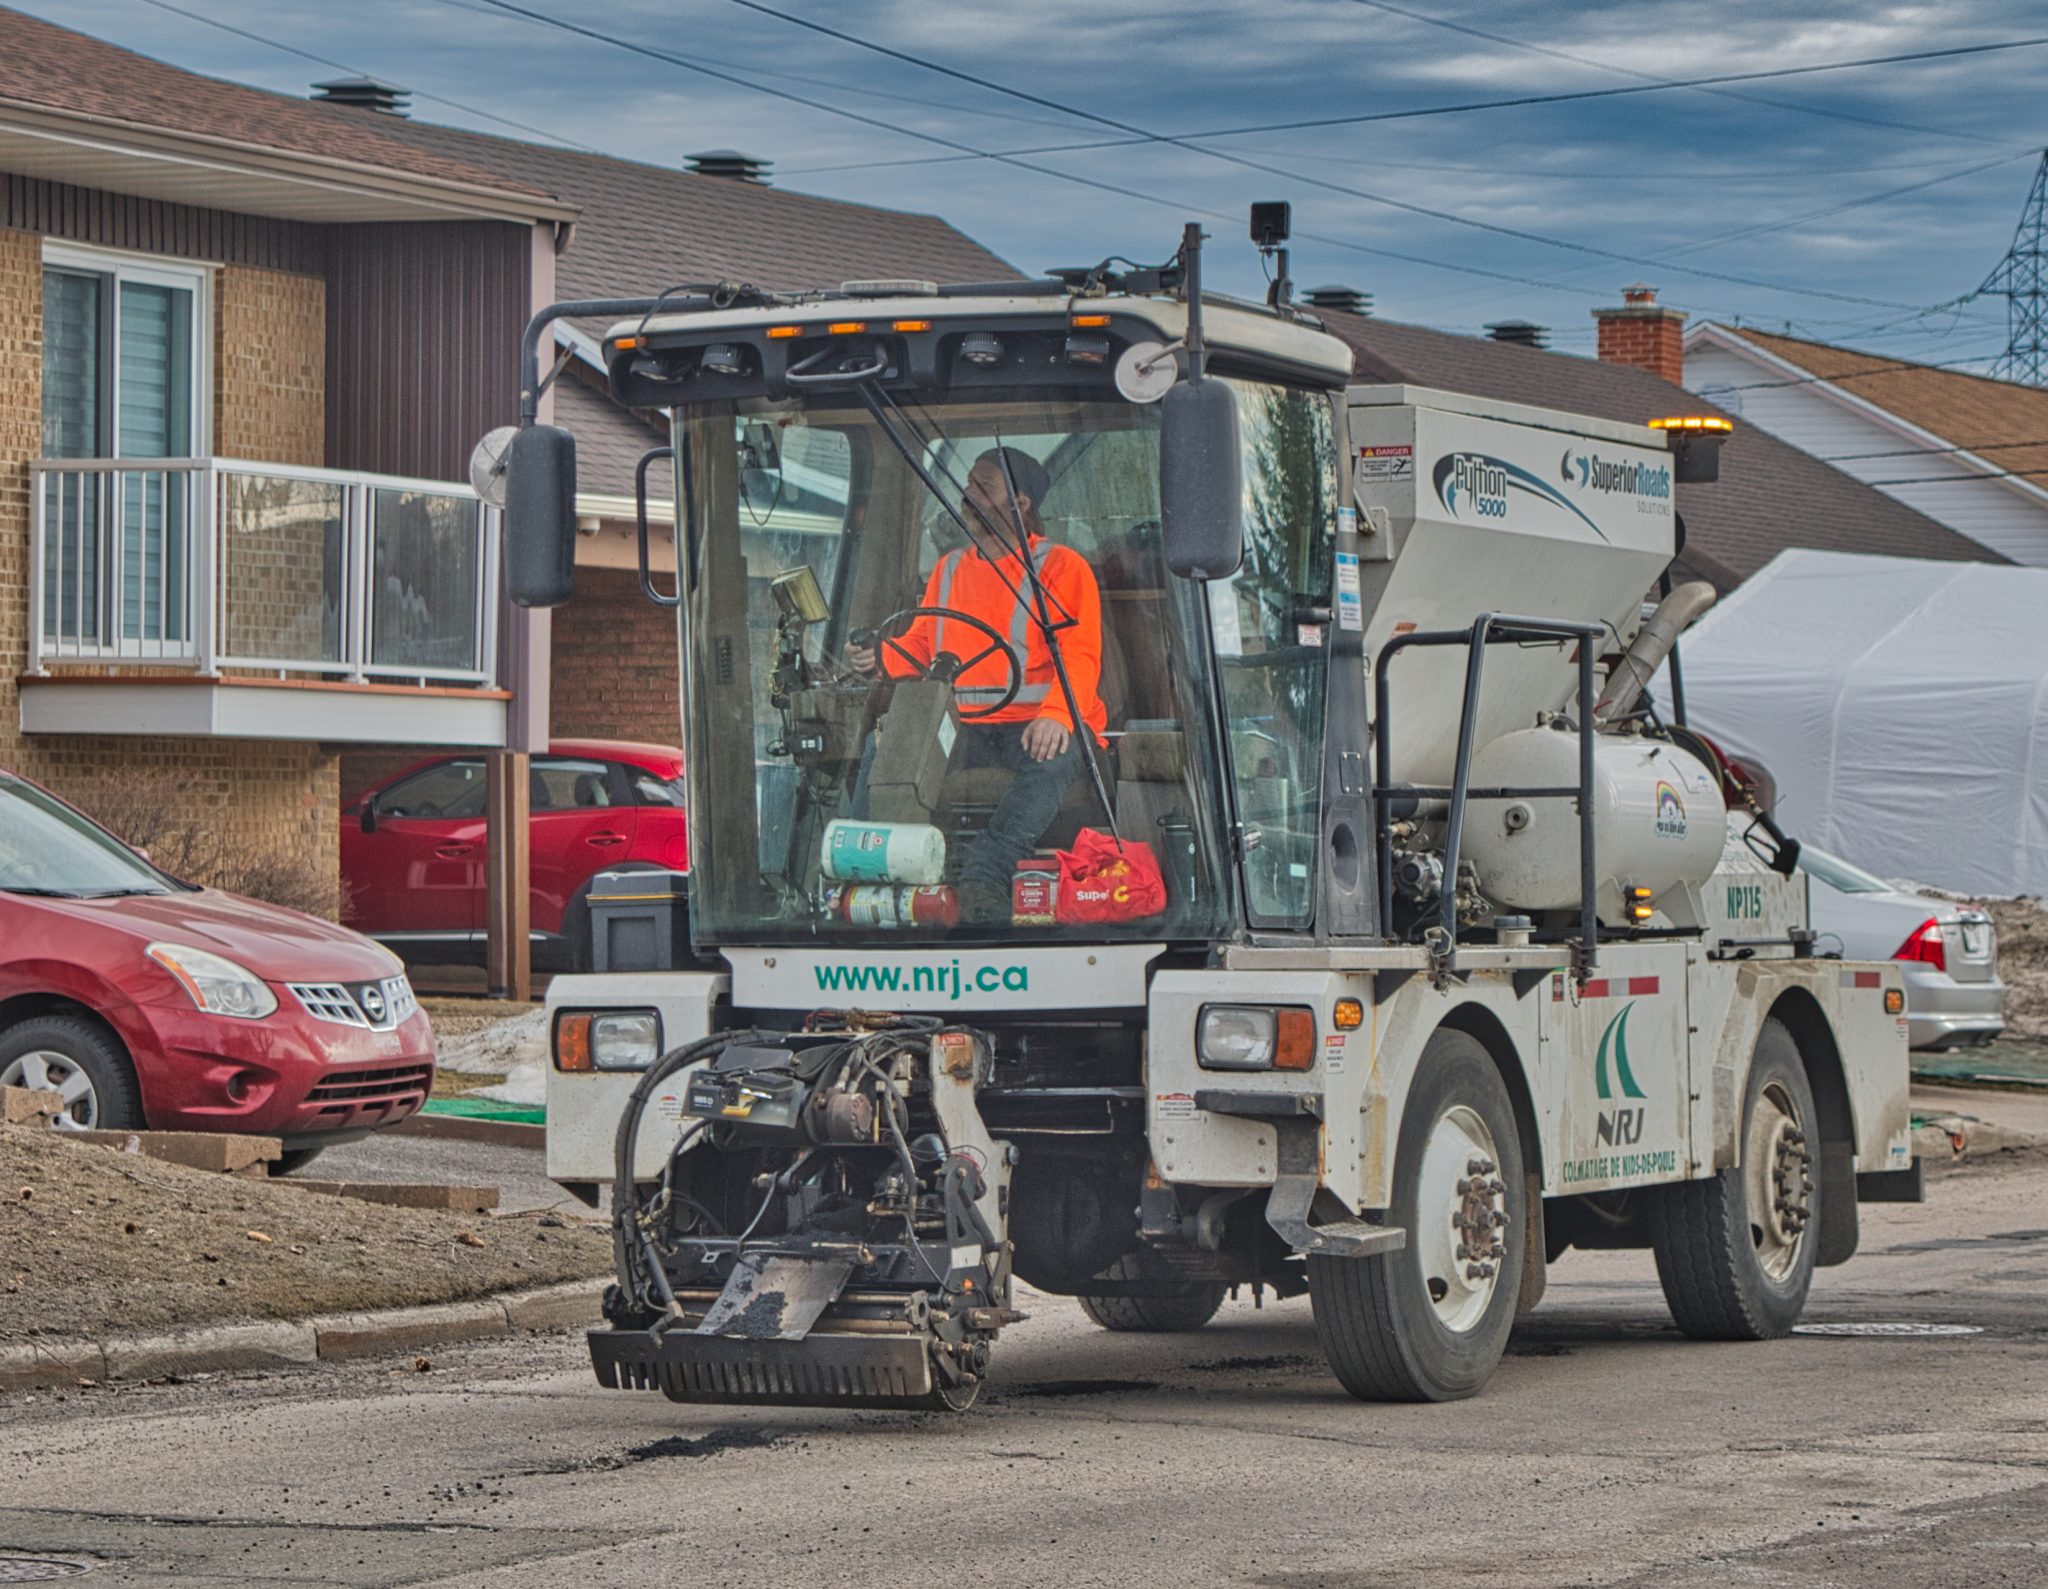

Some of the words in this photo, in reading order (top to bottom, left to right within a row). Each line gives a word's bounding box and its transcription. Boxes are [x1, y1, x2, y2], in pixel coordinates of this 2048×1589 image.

[1375, 448, 1410, 456] DANGER
[1456, 458, 1506, 510] Python
[1478, 497, 1506, 518] 5000
[1637, 500, 1670, 516] SOLUTIONS
[1727, 886, 1762, 919] NP115
[814, 959, 1028, 1000] www.nrj.ca
[1595, 1107, 1645, 1148] NRJ
[1563, 1157, 1608, 1183] COLMATAGE
[1610, 1156, 1620, 1178] DE
[1622, 1150, 1676, 1176] NIDS-DE-POULE
